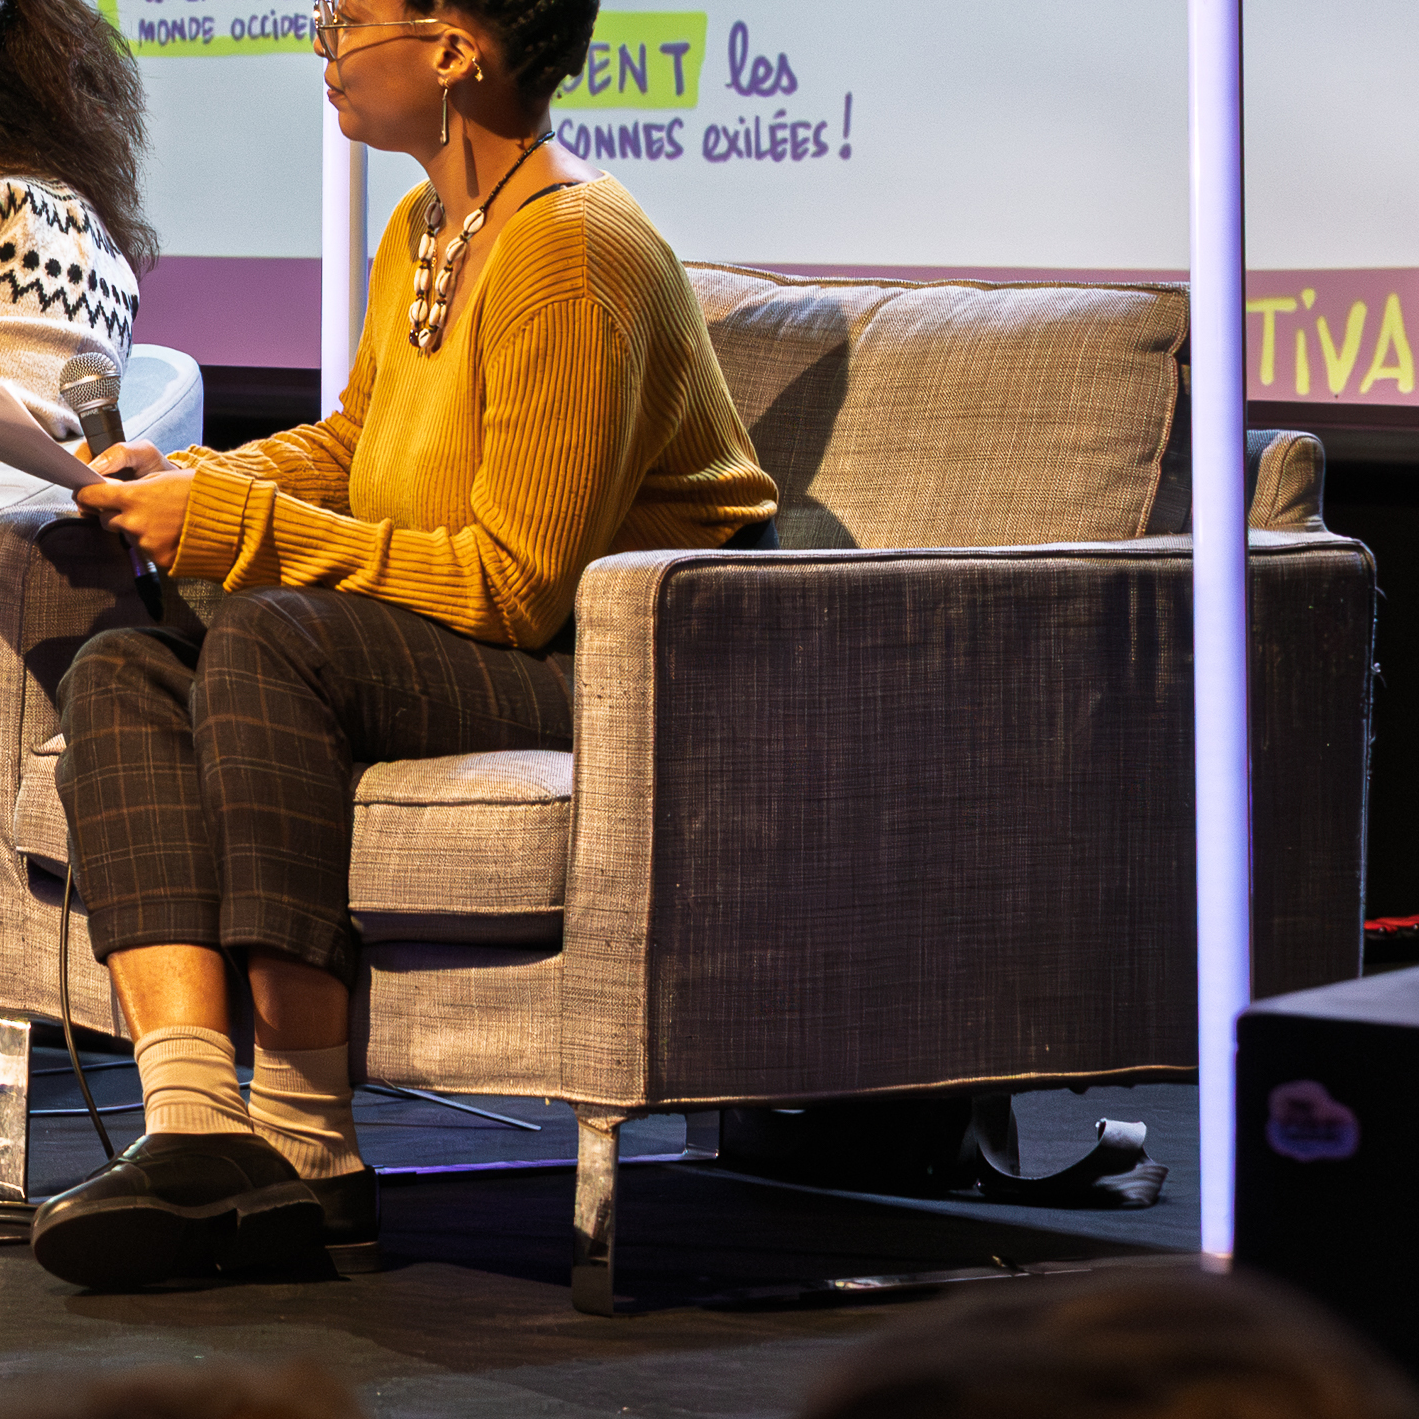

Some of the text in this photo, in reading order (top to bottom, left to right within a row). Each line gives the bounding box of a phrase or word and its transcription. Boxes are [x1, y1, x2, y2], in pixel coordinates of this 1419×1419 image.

[138, 16, 214, 47] MONDE
[725, 19, 798, 97] les
[556, 117, 685, 162] SONNES
[1246, 288, 1413, 396] TIVA
